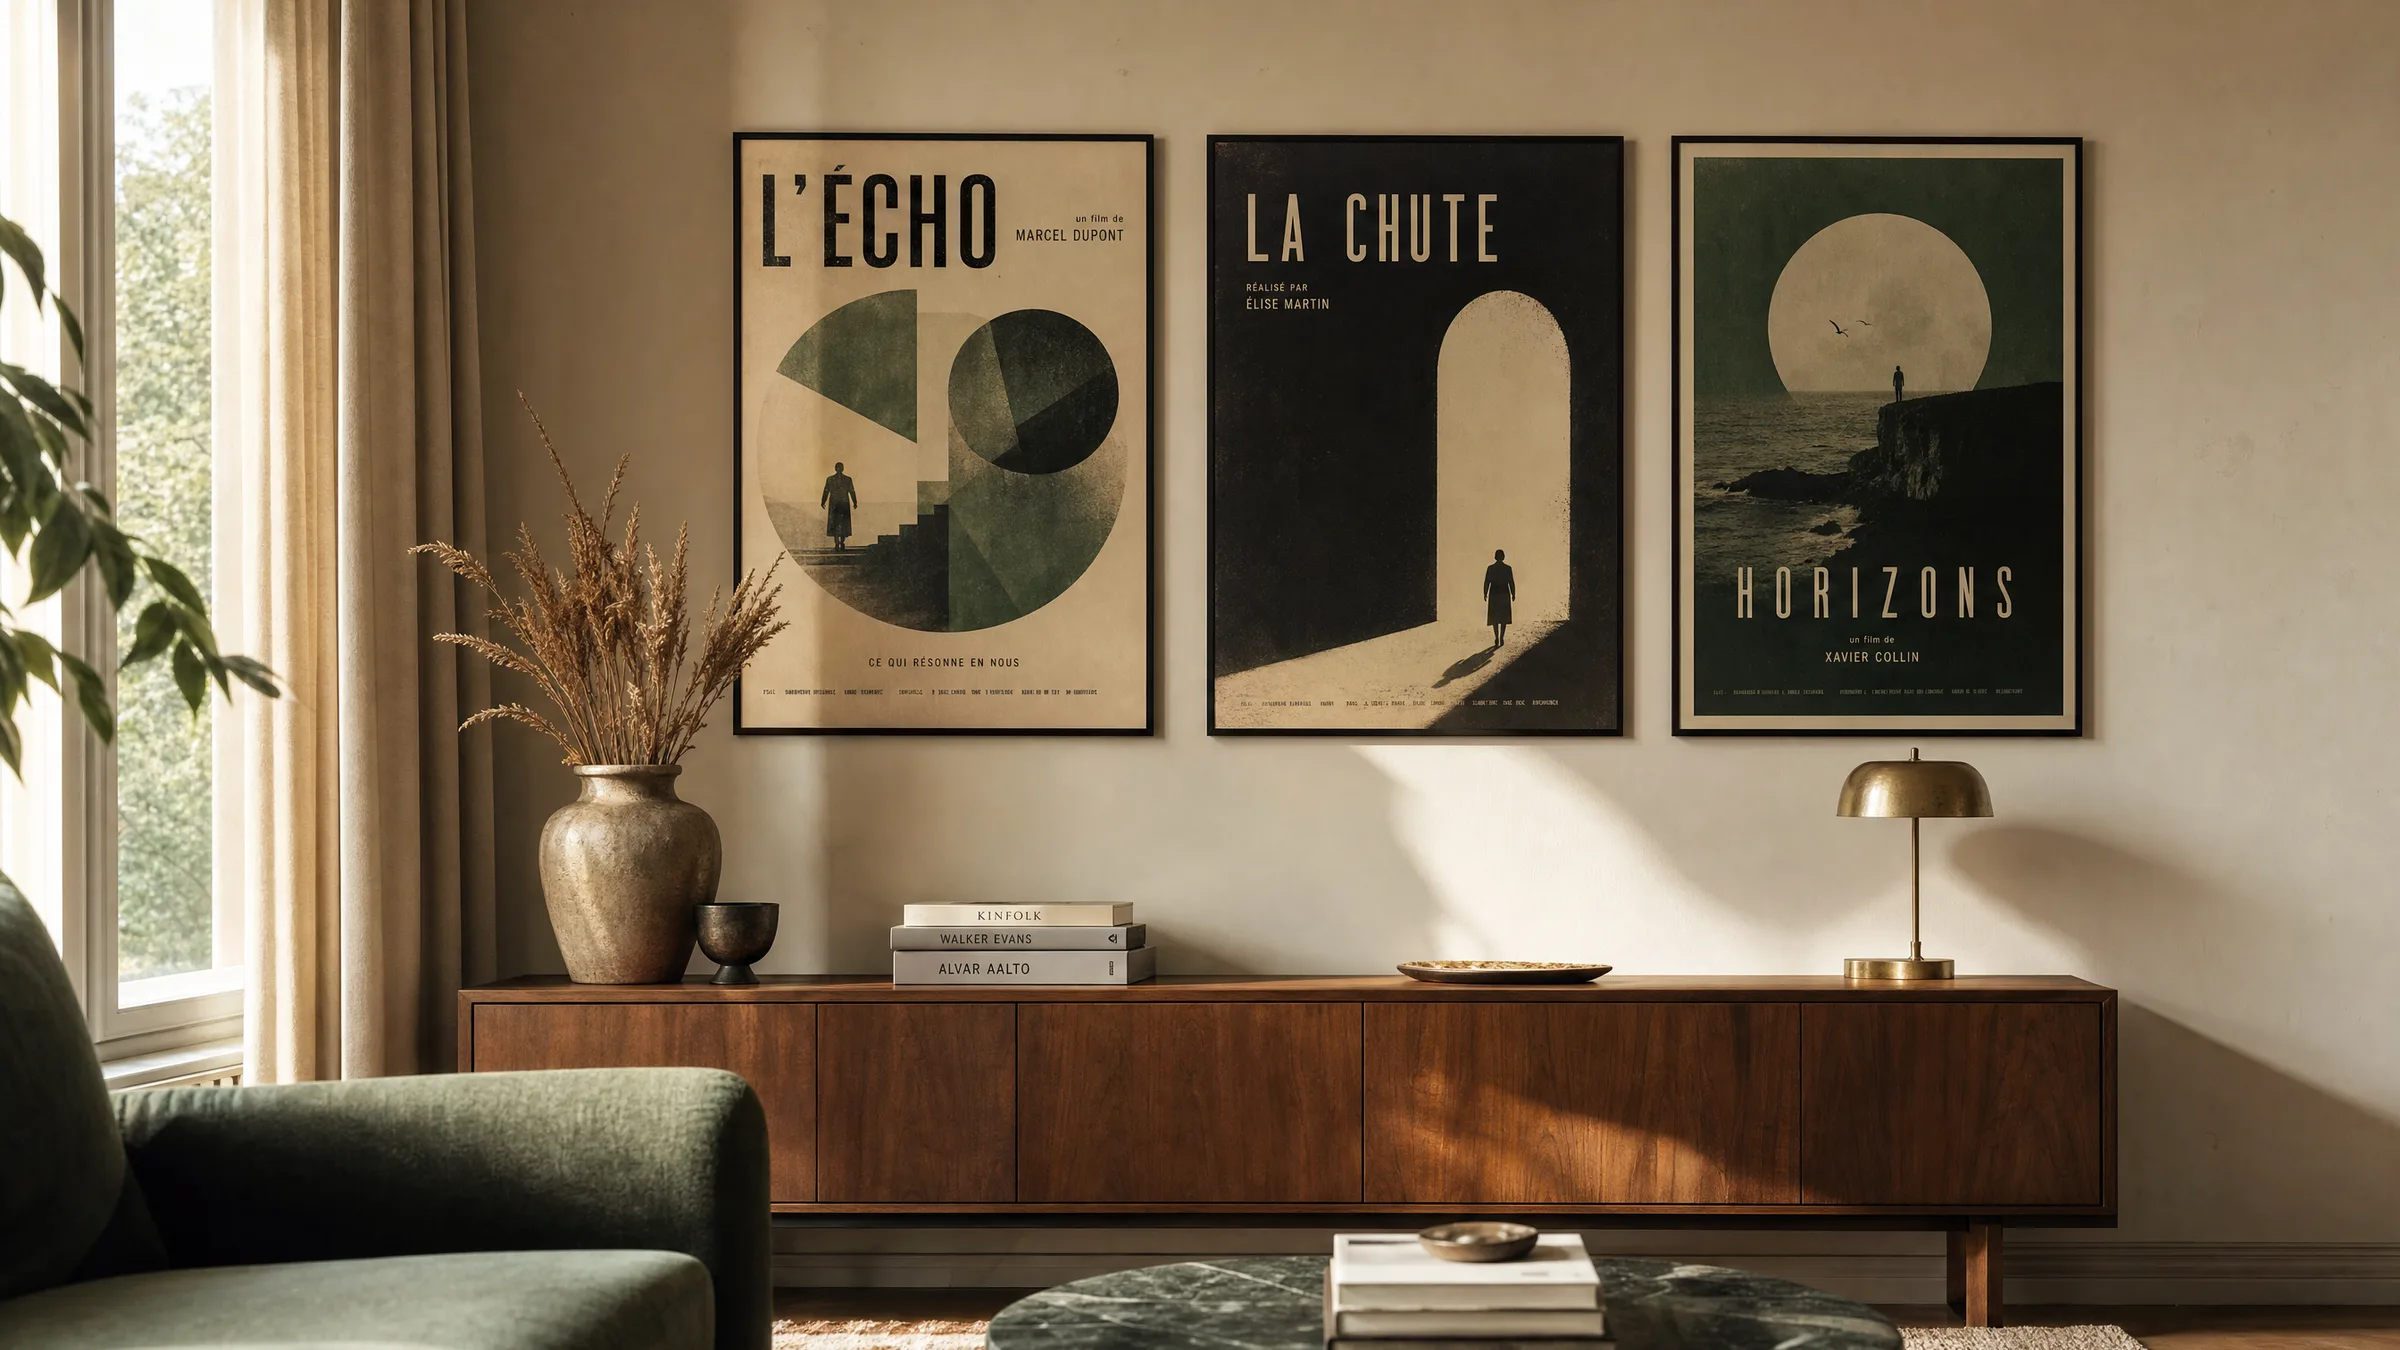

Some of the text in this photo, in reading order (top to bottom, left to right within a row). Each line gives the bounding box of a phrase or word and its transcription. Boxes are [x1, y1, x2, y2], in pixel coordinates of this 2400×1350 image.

[762, 164, 996, 268] L’ÉCHO
[1076, 214, 1124, 223] un film de
[1247, 193, 1498, 262] LA CHUTE
[1016, 229, 1124, 242] MARCEL DUPONT
[1246, 282, 1308, 292] RÉALISÉ PAR
[1246, 296, 1329, 309] ÉLISE MARTIN
[1737, 566, 2012, 618] HORIZONS
[1864, 635, 1880, 644] film
[1884, 635, 1895, 644] de
[869, 656, 1020, 668] CE QUI RÉSONNE EN NOUS
[1825, 651, 1919, 663] XAVIER COLLIN
[977, 911, 1042, 921] KINFOLK
[940, 934, 1032, 944] WALKER EVANS
[939, 963, 1030, 975] ALVAR AALTO
